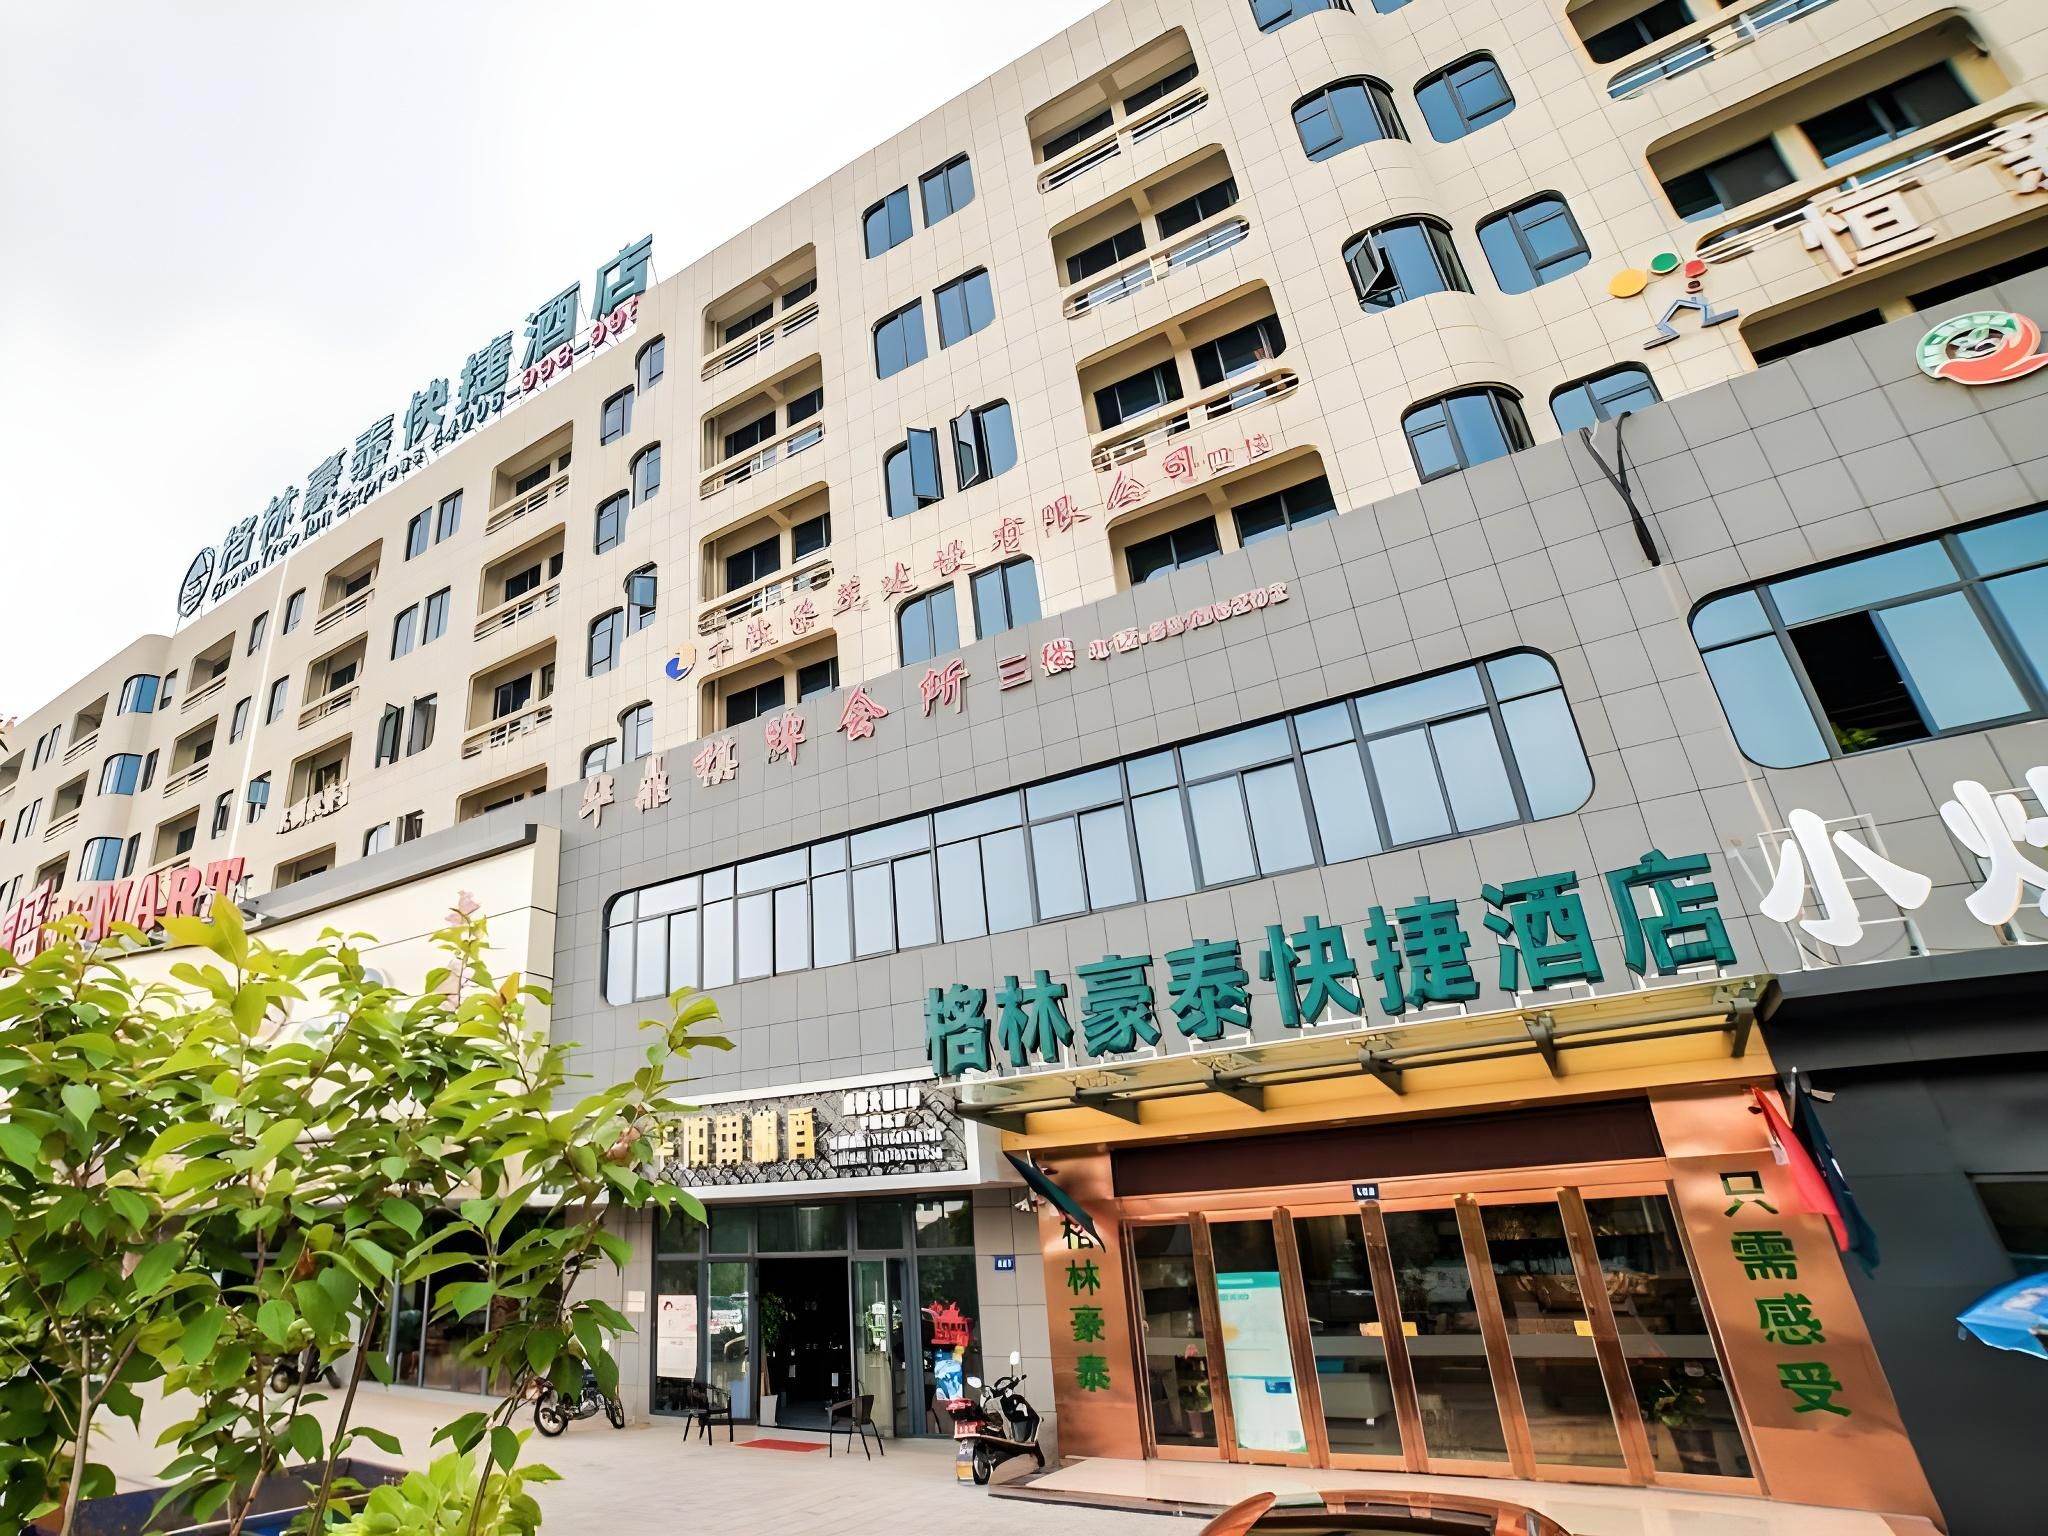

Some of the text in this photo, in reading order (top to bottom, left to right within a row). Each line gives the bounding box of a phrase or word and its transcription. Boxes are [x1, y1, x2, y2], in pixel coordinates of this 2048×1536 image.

[925, 847, 1738, 1077] 格林豪泰快捷酒店
[1718, 1170, 1852, 1418] 只需感受
